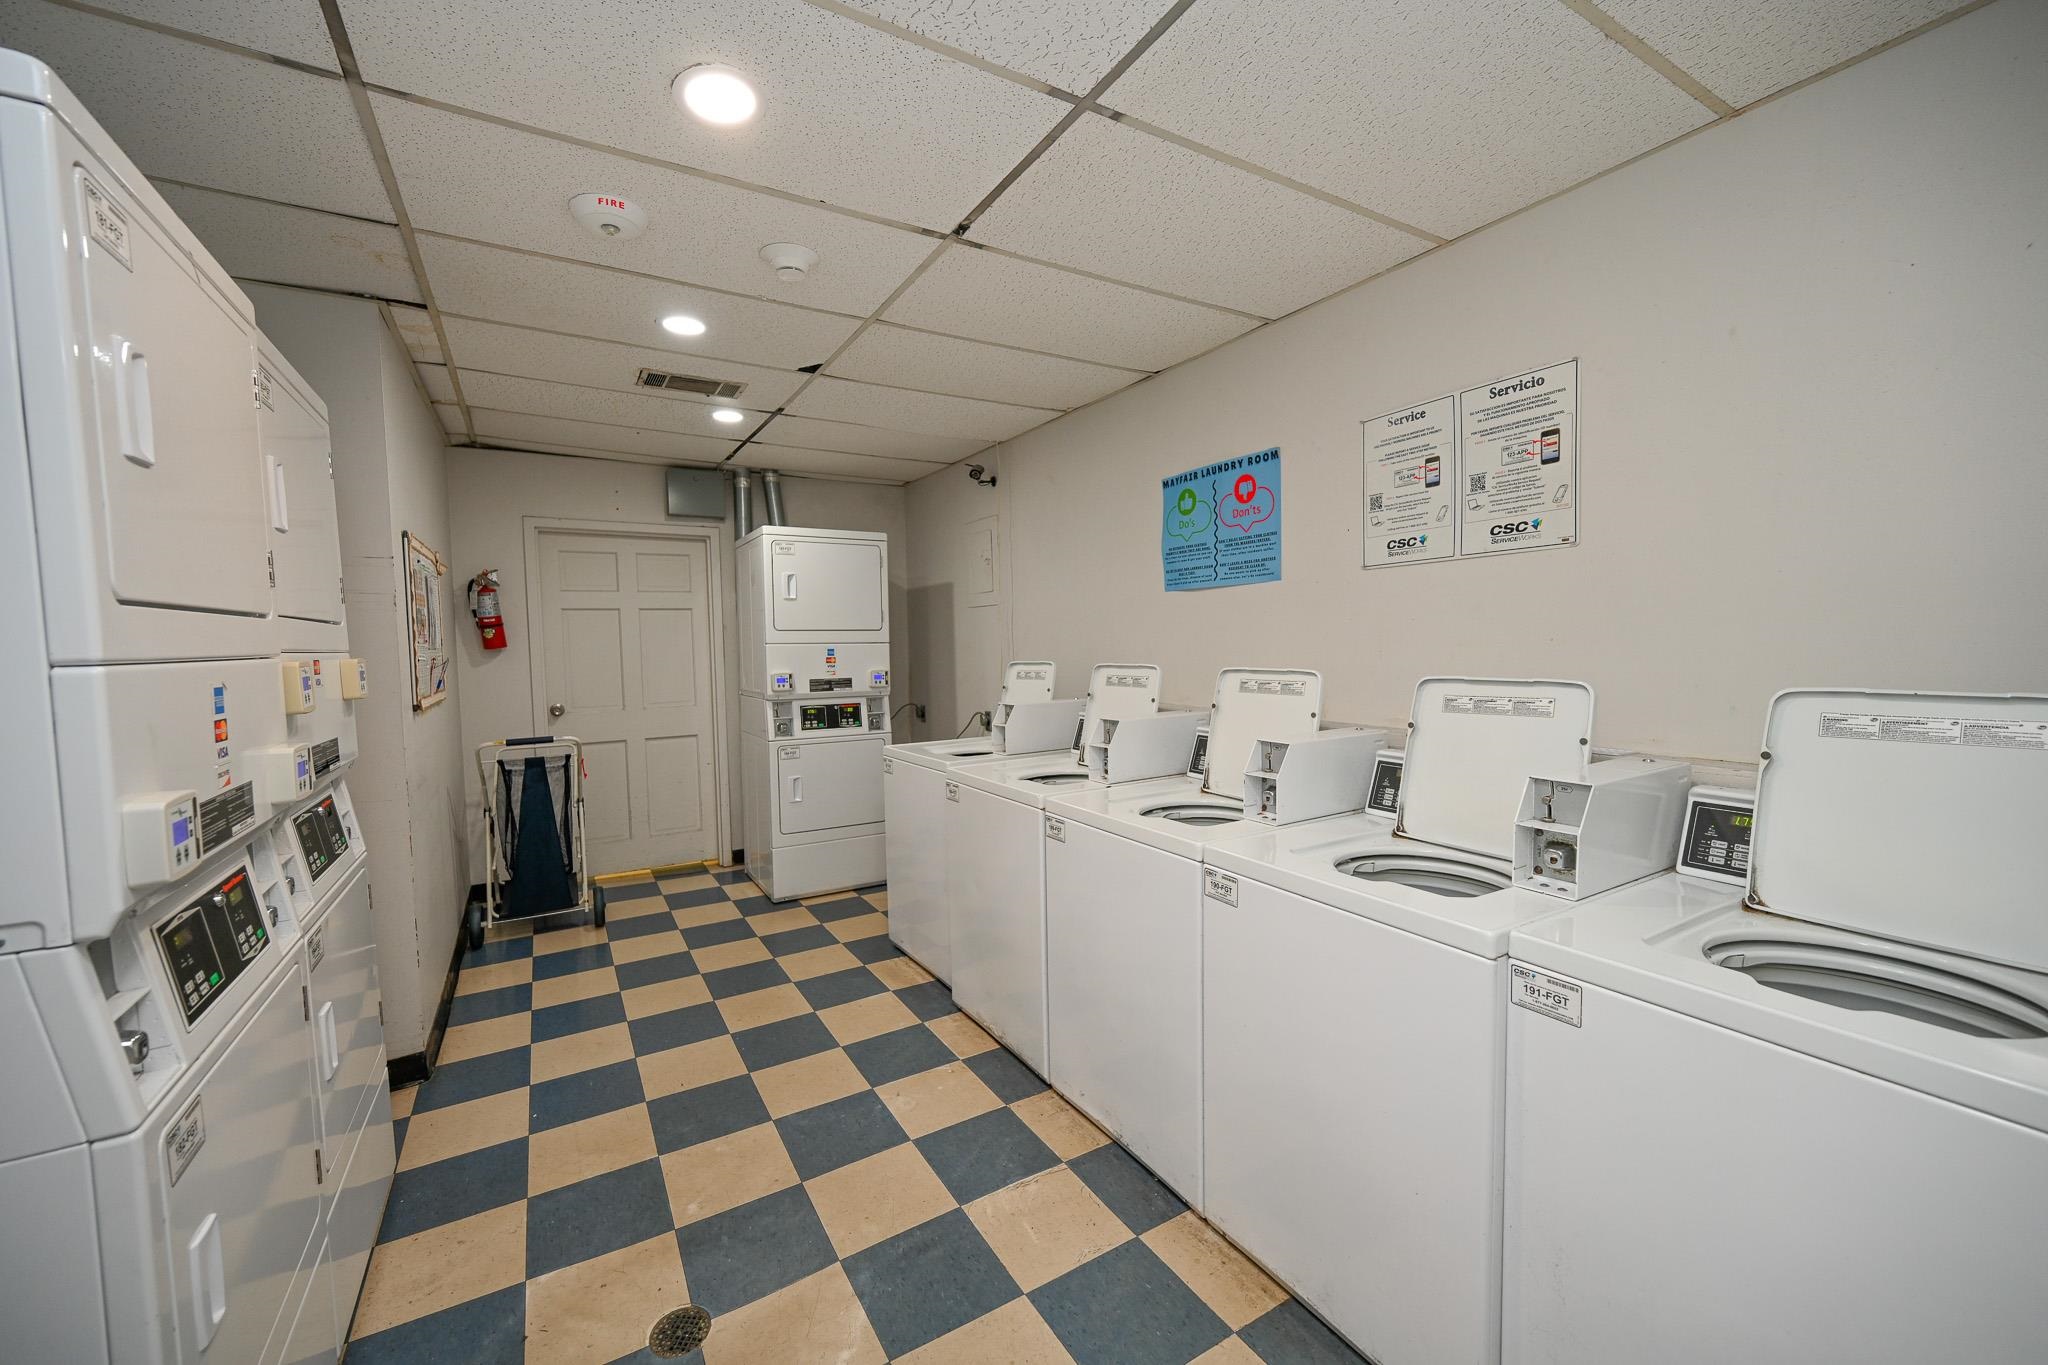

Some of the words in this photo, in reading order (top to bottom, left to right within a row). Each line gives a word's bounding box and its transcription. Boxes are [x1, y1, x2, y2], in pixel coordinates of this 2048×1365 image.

[598, 198, 624, 209] FIRE
[1489, 376, 1545, 400] Servicio
[1387, 409, 1426, 428] Service
[1162, 472, 1198, 489] MAYFAIR
[1202, 459, 1244, 478] LAUNDRY
[1248, 450, 1280, 466] ROOM
[1232, 506, 1261, 518] Don'ts
[1179, 518, 1196, 530] Do's
[1490, 521, 1529, 536] CSC
[1387, 537, 1417, 550] CSC
[217, 746, 228, 759] VISA
[1514, 968, 1530, 977] CSC
[1524, 984, 1569, 1006] 191-FGT
